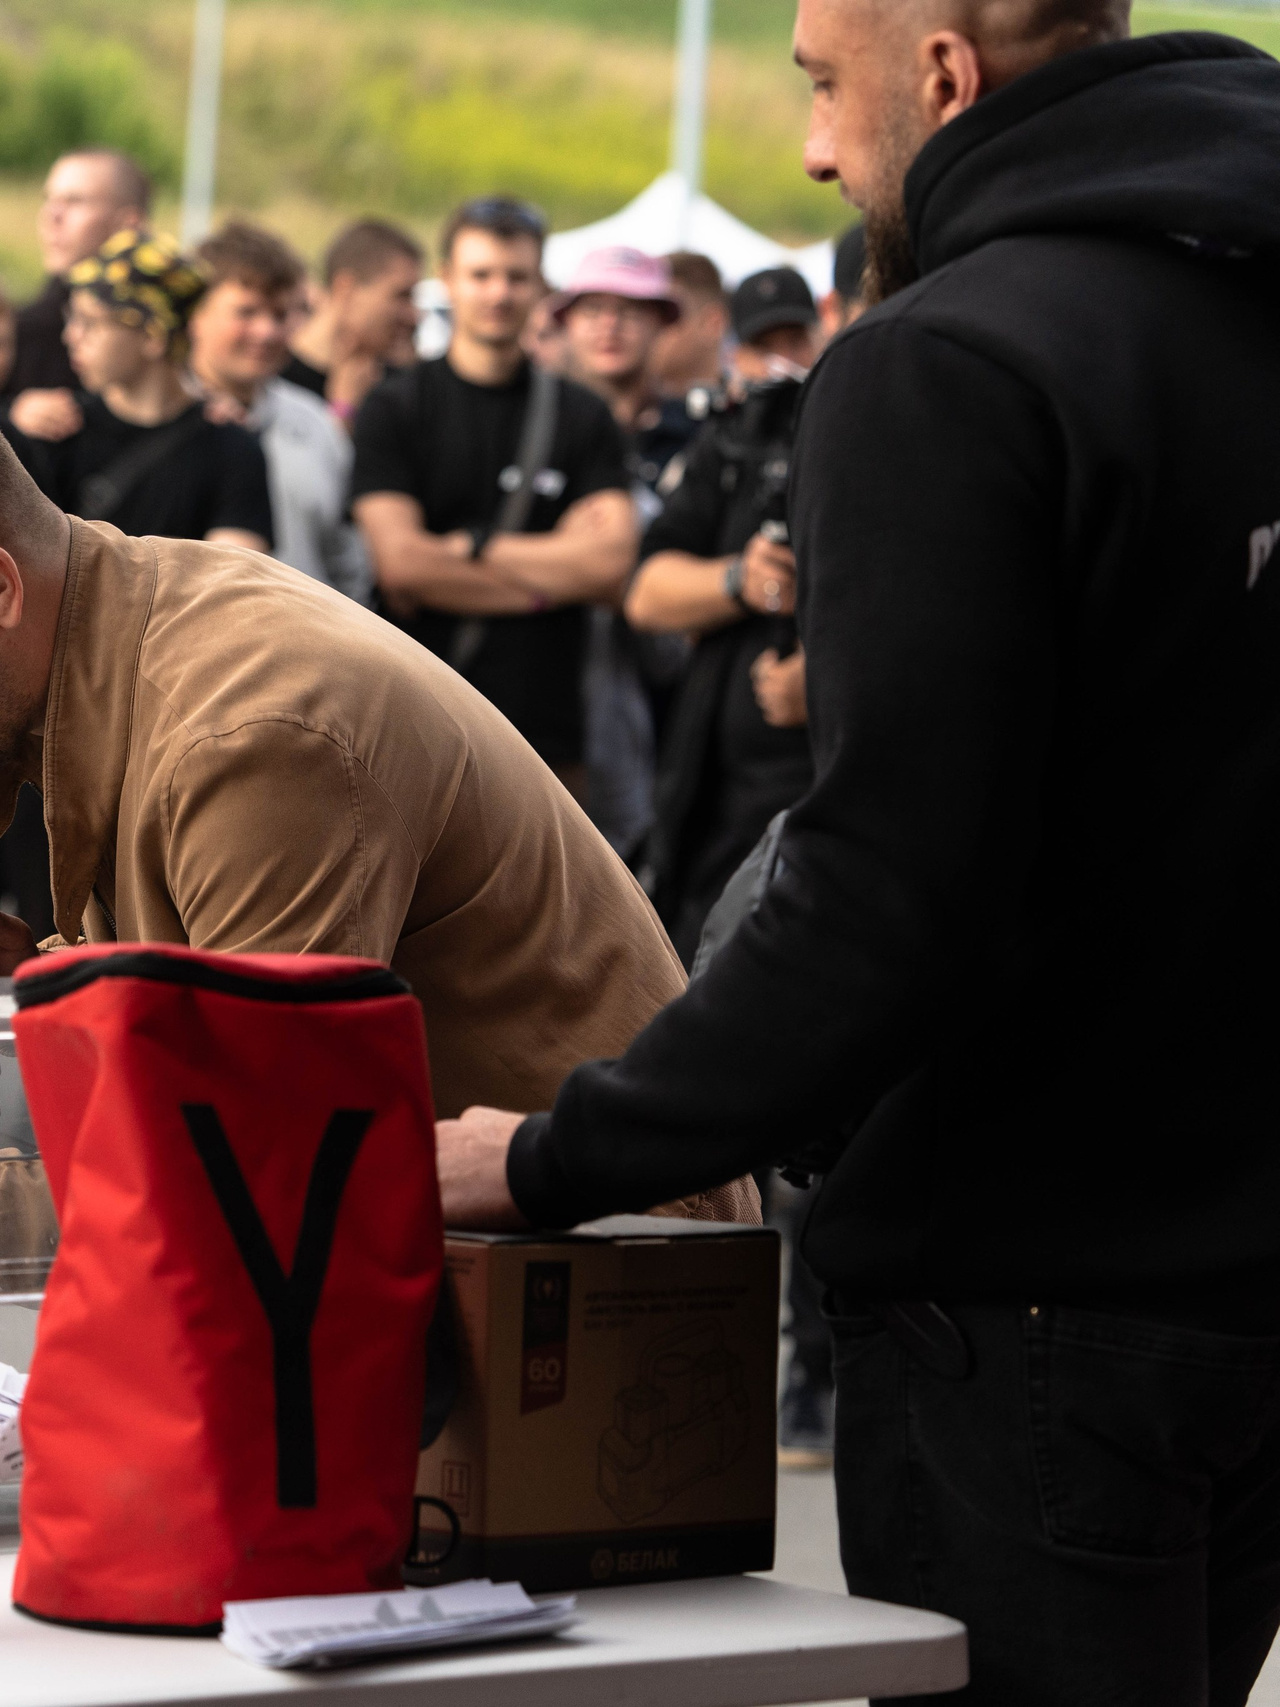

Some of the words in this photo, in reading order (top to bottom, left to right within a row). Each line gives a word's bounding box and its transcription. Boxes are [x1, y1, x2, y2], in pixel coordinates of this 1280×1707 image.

[180, 1103, 377, 1509] Y
[528, 1357, 561, 1382] 60
[617, 1548, 679, 1573] БЕЛАК
